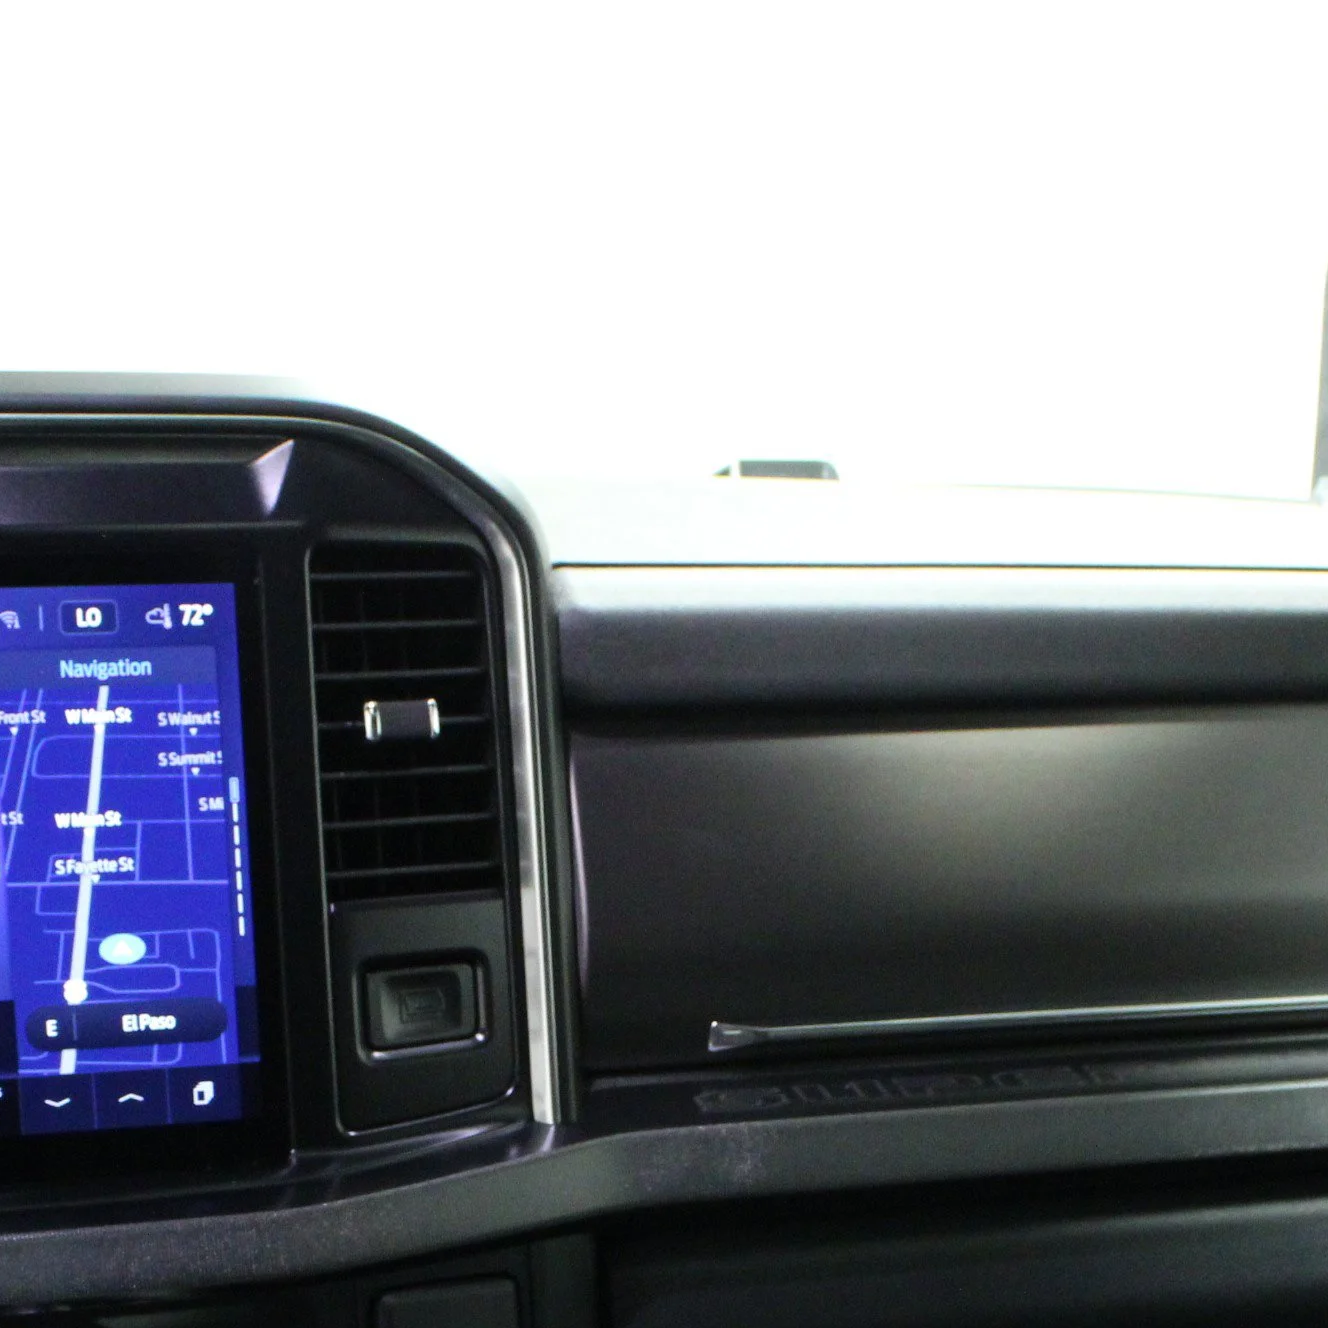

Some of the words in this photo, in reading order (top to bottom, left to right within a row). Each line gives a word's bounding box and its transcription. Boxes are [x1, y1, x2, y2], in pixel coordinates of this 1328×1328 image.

[76, 607, 101, 627] LO
[60, 659, 152, 680] Navigation
[31, 710, 46, 724] St
[64, 709, 81, 725] W
[115, 707, 133, 724] St
[158, 712, 167, 727] S
[168, 711, 213, 726] Walnut
[158, 752, 167, 767] S
[168, 751, 216, 766] Summit
[198, 797, 208, 811] S
[54, 813, 70, 829] W
[105, 810, 122, 826] St
[54, 860, 65, 875] S
[118, 857, 135, 873] St
[47, 1020, 58, 1038] E
[122, 1015, 138, 1033] El
[139, 1014, 176, 1032] Paso
